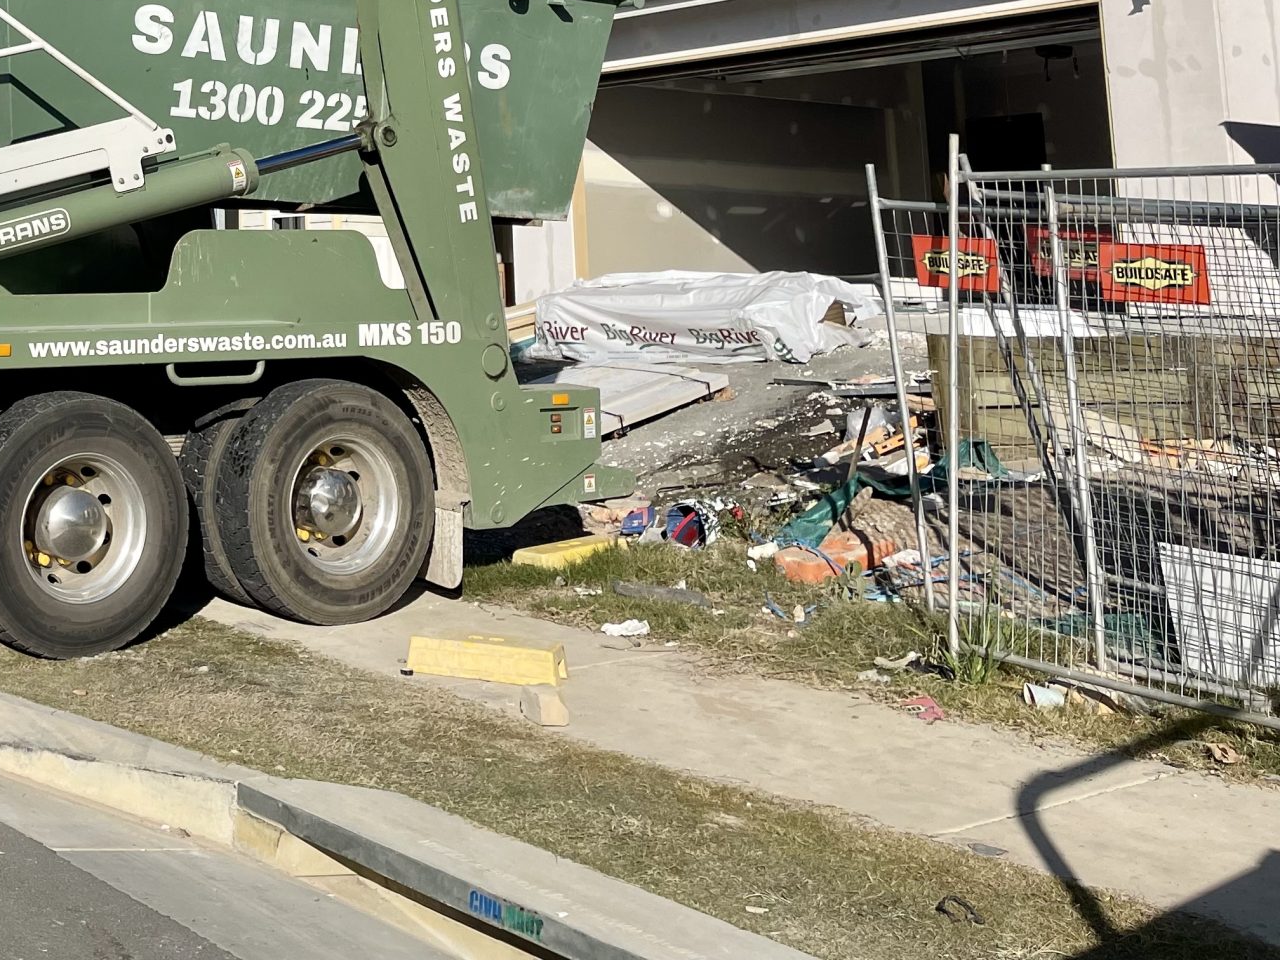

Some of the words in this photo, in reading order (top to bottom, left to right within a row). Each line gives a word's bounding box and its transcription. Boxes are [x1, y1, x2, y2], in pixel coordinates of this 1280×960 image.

[170, 78, 285, 126] 1300
[443, 92, 479, 225] WASTE
[928, 256, 984, 271] BUILSAFE
[1116, 266, 1189, 282] BUILDSAFE
[29, 332, 347, 358] www.saunderswaste.com.au
[358, 323, 413, 347] MXS
[417, 321, 461, 345] 150
[601, 322, 677, 347] BigRiver
[688, 328, 762, 350] BigRive
